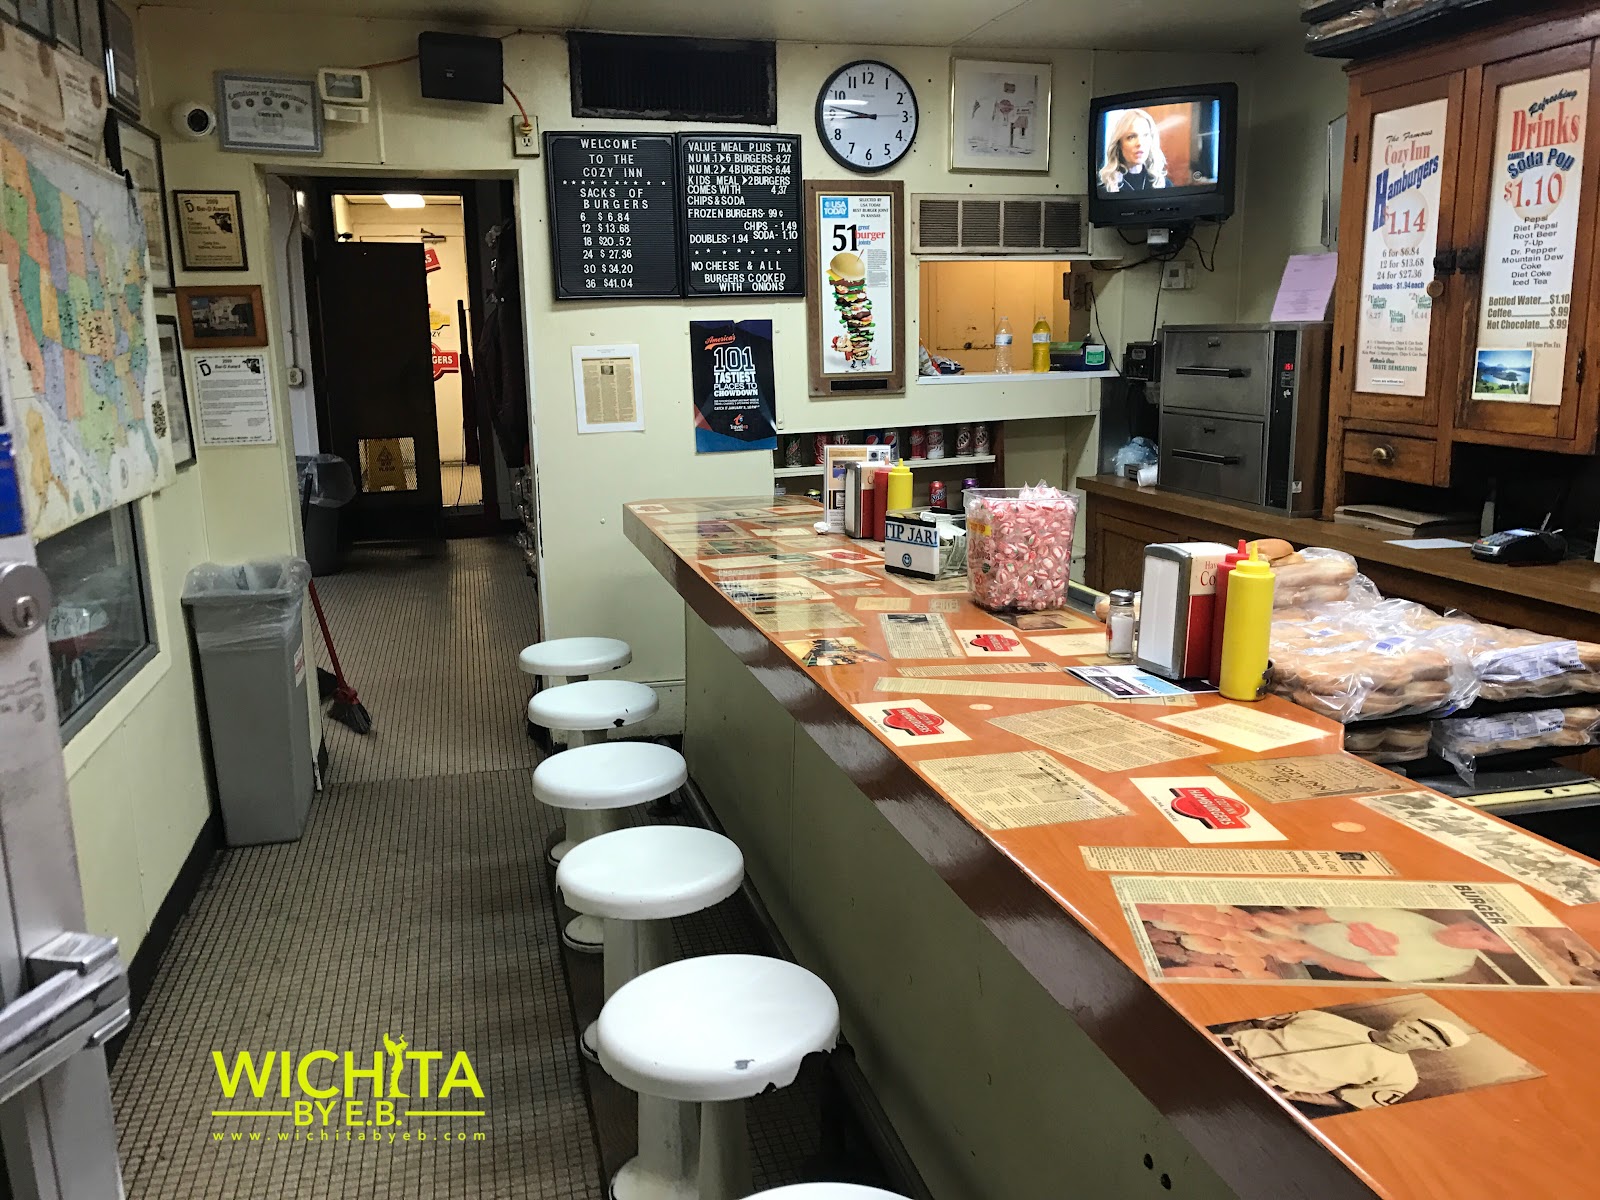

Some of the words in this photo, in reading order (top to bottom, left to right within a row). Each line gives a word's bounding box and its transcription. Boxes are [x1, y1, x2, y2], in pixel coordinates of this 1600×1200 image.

[849, 76, 856, 88] 11
[863, 72, 874, 84] 12
[897, 93, 903, 104] 2
[902, 111, 908, 122] 3
[1510, 101, 1580, 152] Drinks
[835, 129, 841, 140] 8
[895, 130, 902, 141] 4
[1386, 135, 1399, 143] The
[1403, 130, 1433, 141] Famous
[581, 139, 638, 149] WELCOME
[688, 142, 716, 152] VALUE
[721, 142, 744, 152] MEAL
[749, 143, 771, 152] PLUS
[777, 143, 792, 152] TAX
[849, 143, 855, 154] 7
[866, 149, 872, 160] 6
[884, 144, 890, 155] 5
[589, 154, 603, 164] TO
[614, 155, 634, 164] THE
[1507, 151, 1543, 179] Soda
[1547, 148, 1575, 171] Pop
[583, 168, 613, 177] COZY
[624, 168, 642, 177] INN
[688, 176, 710, 185] KIDS
[716, 176, 739, 185] MEAL
[580, 188, 616, 198] SACKS
[629, 189, 643, 198] OF
[687, 185, 717, 194] COMES
[720, 185, 740, 194] WITH
[1372, 155, 1439, 232] Hamburgers
[1504, 172, 1563, 208] $1.10
[583, 199, 648, 209] BURGERS
[580, 212, 586, 222] 6
[688, 209, 724, 218] FROZEN
[1525, 215, 1548, 223] Pepsi
[582, 224, 591, 233] 12
[744, 221, 768, 231] CHIPS
[1534, 222, 1558, 230] Pepsi
[782, 231, 798, 240] 1.10
[833, 224, 858, 251] 51
[855, 230, 885, 241] burger
[583, 237, 592, 246] 18
[583, 250, 593, 259] 24
[1389, 249, 1398, 257] for
[1400, 247, 1419, 256] $6.84
[1525, 247, 1557, 255] Pepper
[691, 262, 703, 271] NO
[705, 261, 739, 270] CHEESE
[747, 261, 753, 270] &
[760, 261, 781, 270] ALL
[1380, 261, 1387, 269] 12
[1389, 260, 1399, 268] for
[1401, 258, 1424, 267] $13.68
[584, 264, 596, 274] 30
[705, 274, 745, 283] BURGERS
[748, 273, 785, 283] COOKED
[1377, 271, 1384, 280] 24
[1387, 271, 1397, 279] for
[1399, 270, 1422, 279] $27.36
[586, 279, 596, 288] 36
[604, 278, 633, 288] $41.04
[719, 283, 742, 292] WITH
[752, 282, 784, 291] ONIONS
[1489, 296, 1515, 306] Bottled
[1487, 320, 1499, 329] Hot
[714, 346, 755, 372] 101
[714, 371, 756, 383] TASTIEST
[714, 389, 758, 397] CHOWDOWN
[885, 522, 904, 539] TIP
[908, 527, 937, 545] JAR!
[1188, 789, 1235, 826] HAMBURGERS
[1453, 885, 1508, 925] BURGER
